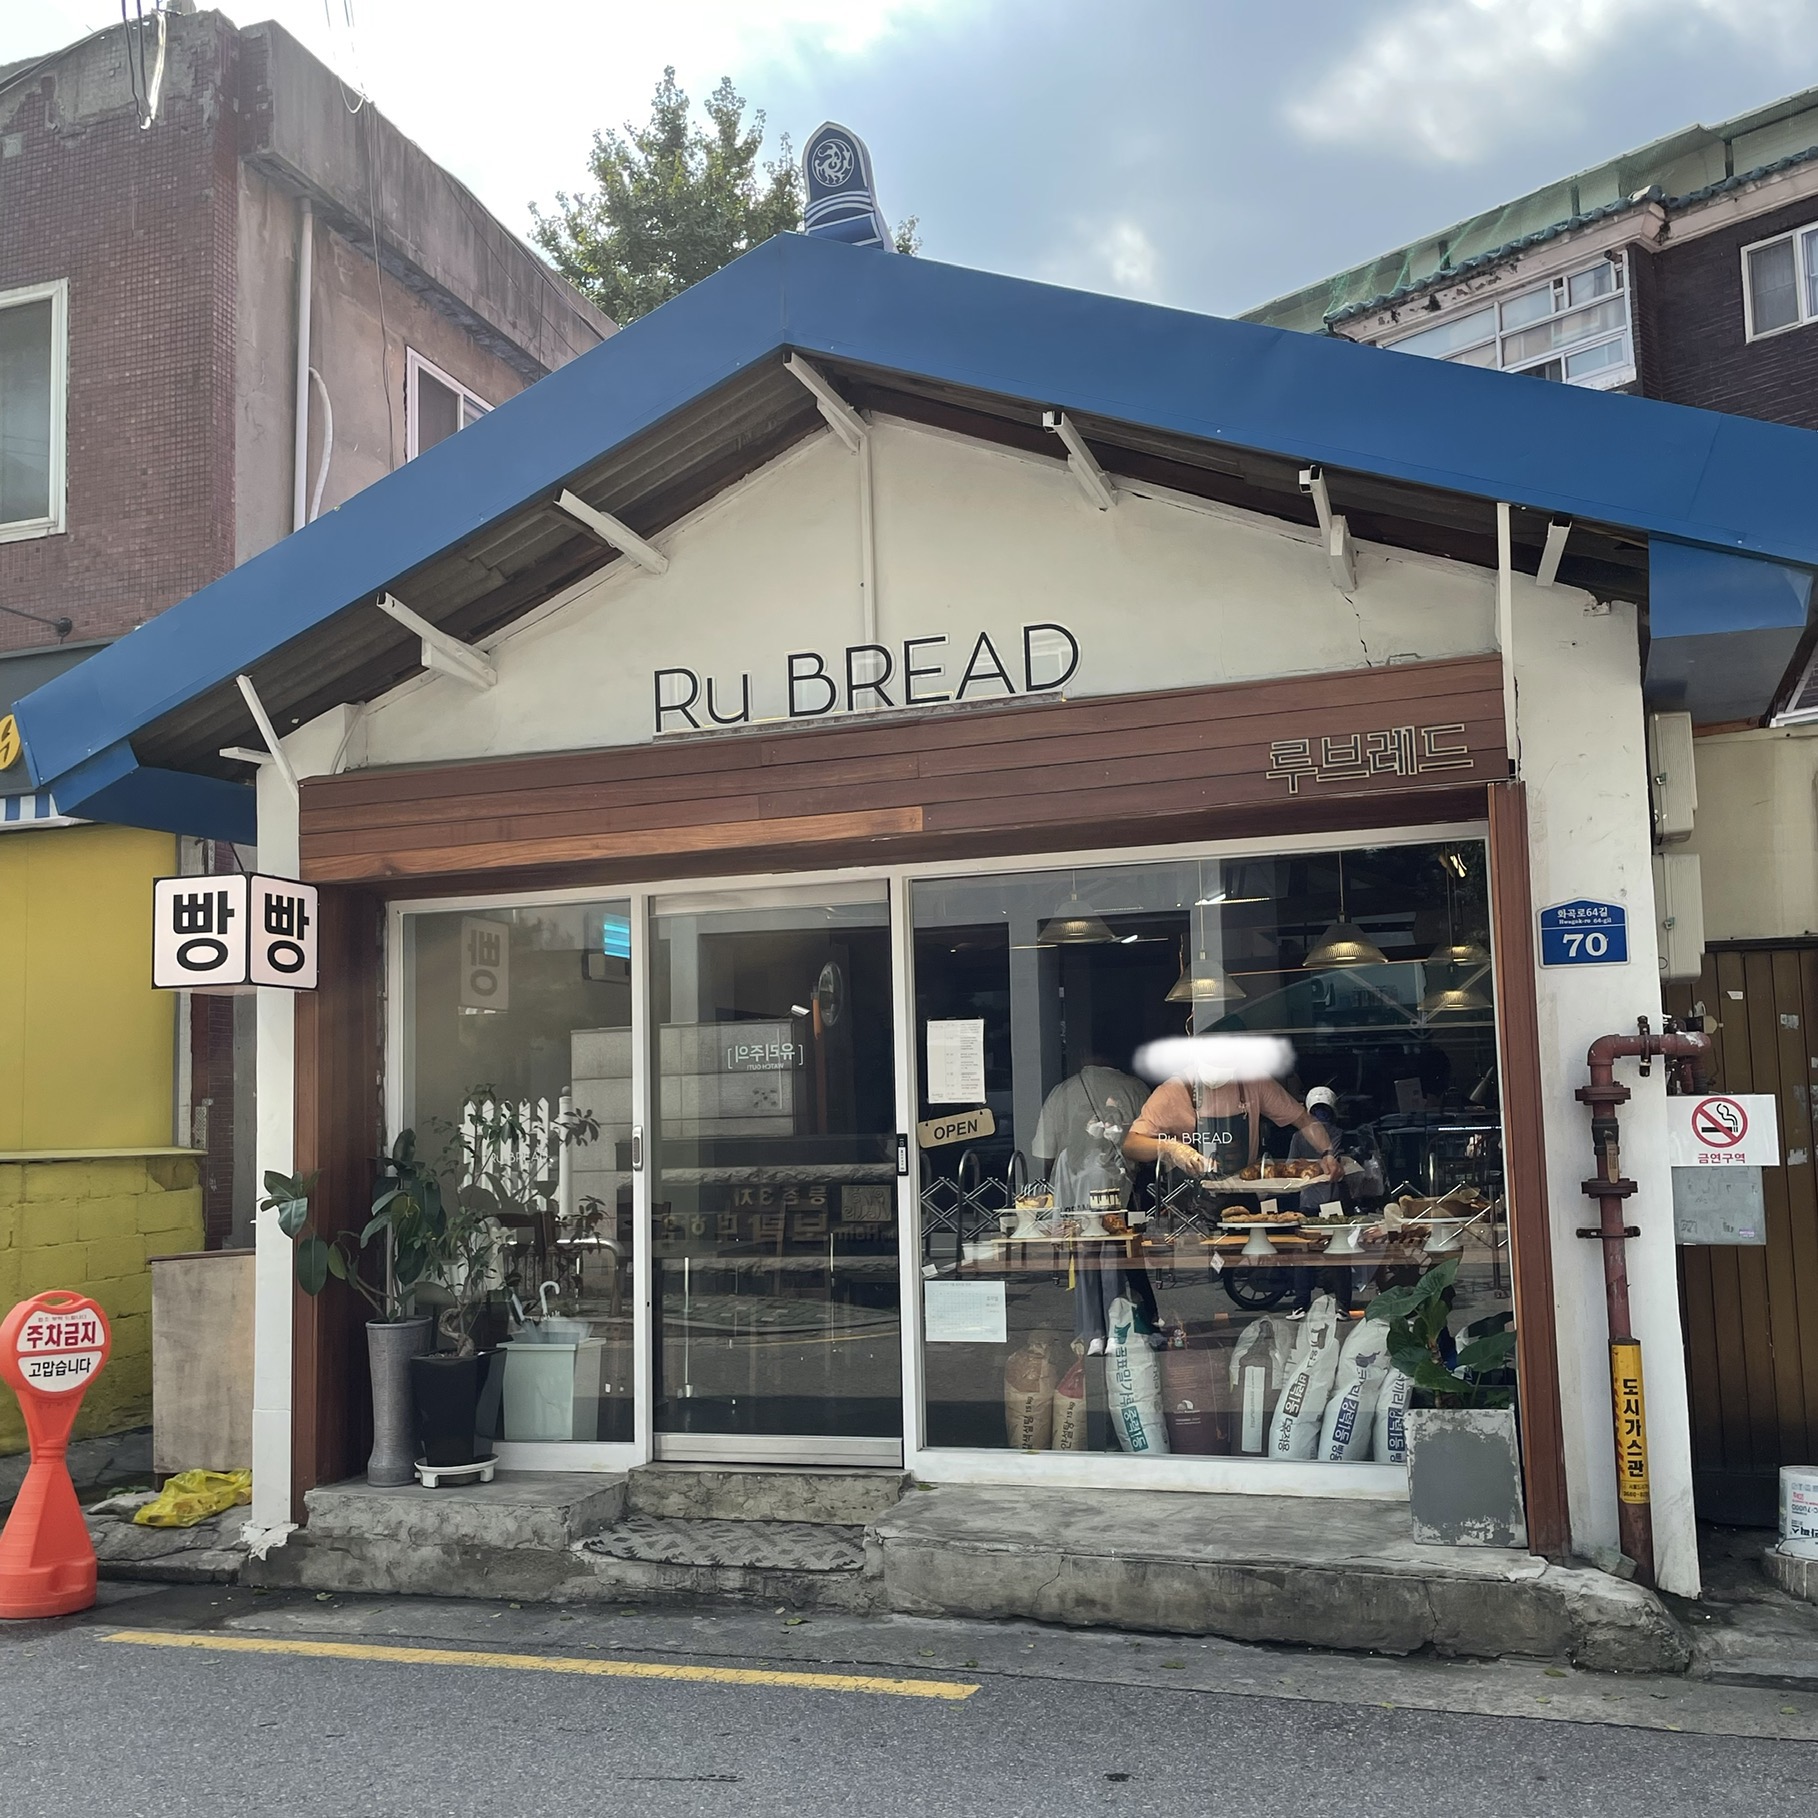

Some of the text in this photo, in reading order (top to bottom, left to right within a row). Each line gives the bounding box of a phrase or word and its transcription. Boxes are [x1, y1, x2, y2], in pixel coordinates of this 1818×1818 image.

[654, 623, 1080, 733] Ru BREAD
[1266, 723, 1474, 794] 루브레드
[173, 890, 235, 972] 빵
[1557, 907, 1608, 919] 화곡로64길
[264, 892, 310, 974] 빵
[1563, 932, 1608, 957] 70
[934, 1119, 978, 1140] OPEN
[1158, 1131, 1233, 1145] Ru BREAD
[1697, 1153, 1746, 1164] 금연구역
[26, 1320, 97, 1350] 주차금지
[28, 1357, 92, 1378] 고맙습니다
[1334, 1400, 1358, 1443] 강력1등
[1388, 1408, 1404, 1450] 강력1등
[1622, 1378, 1644, 1477] 도시가스관
